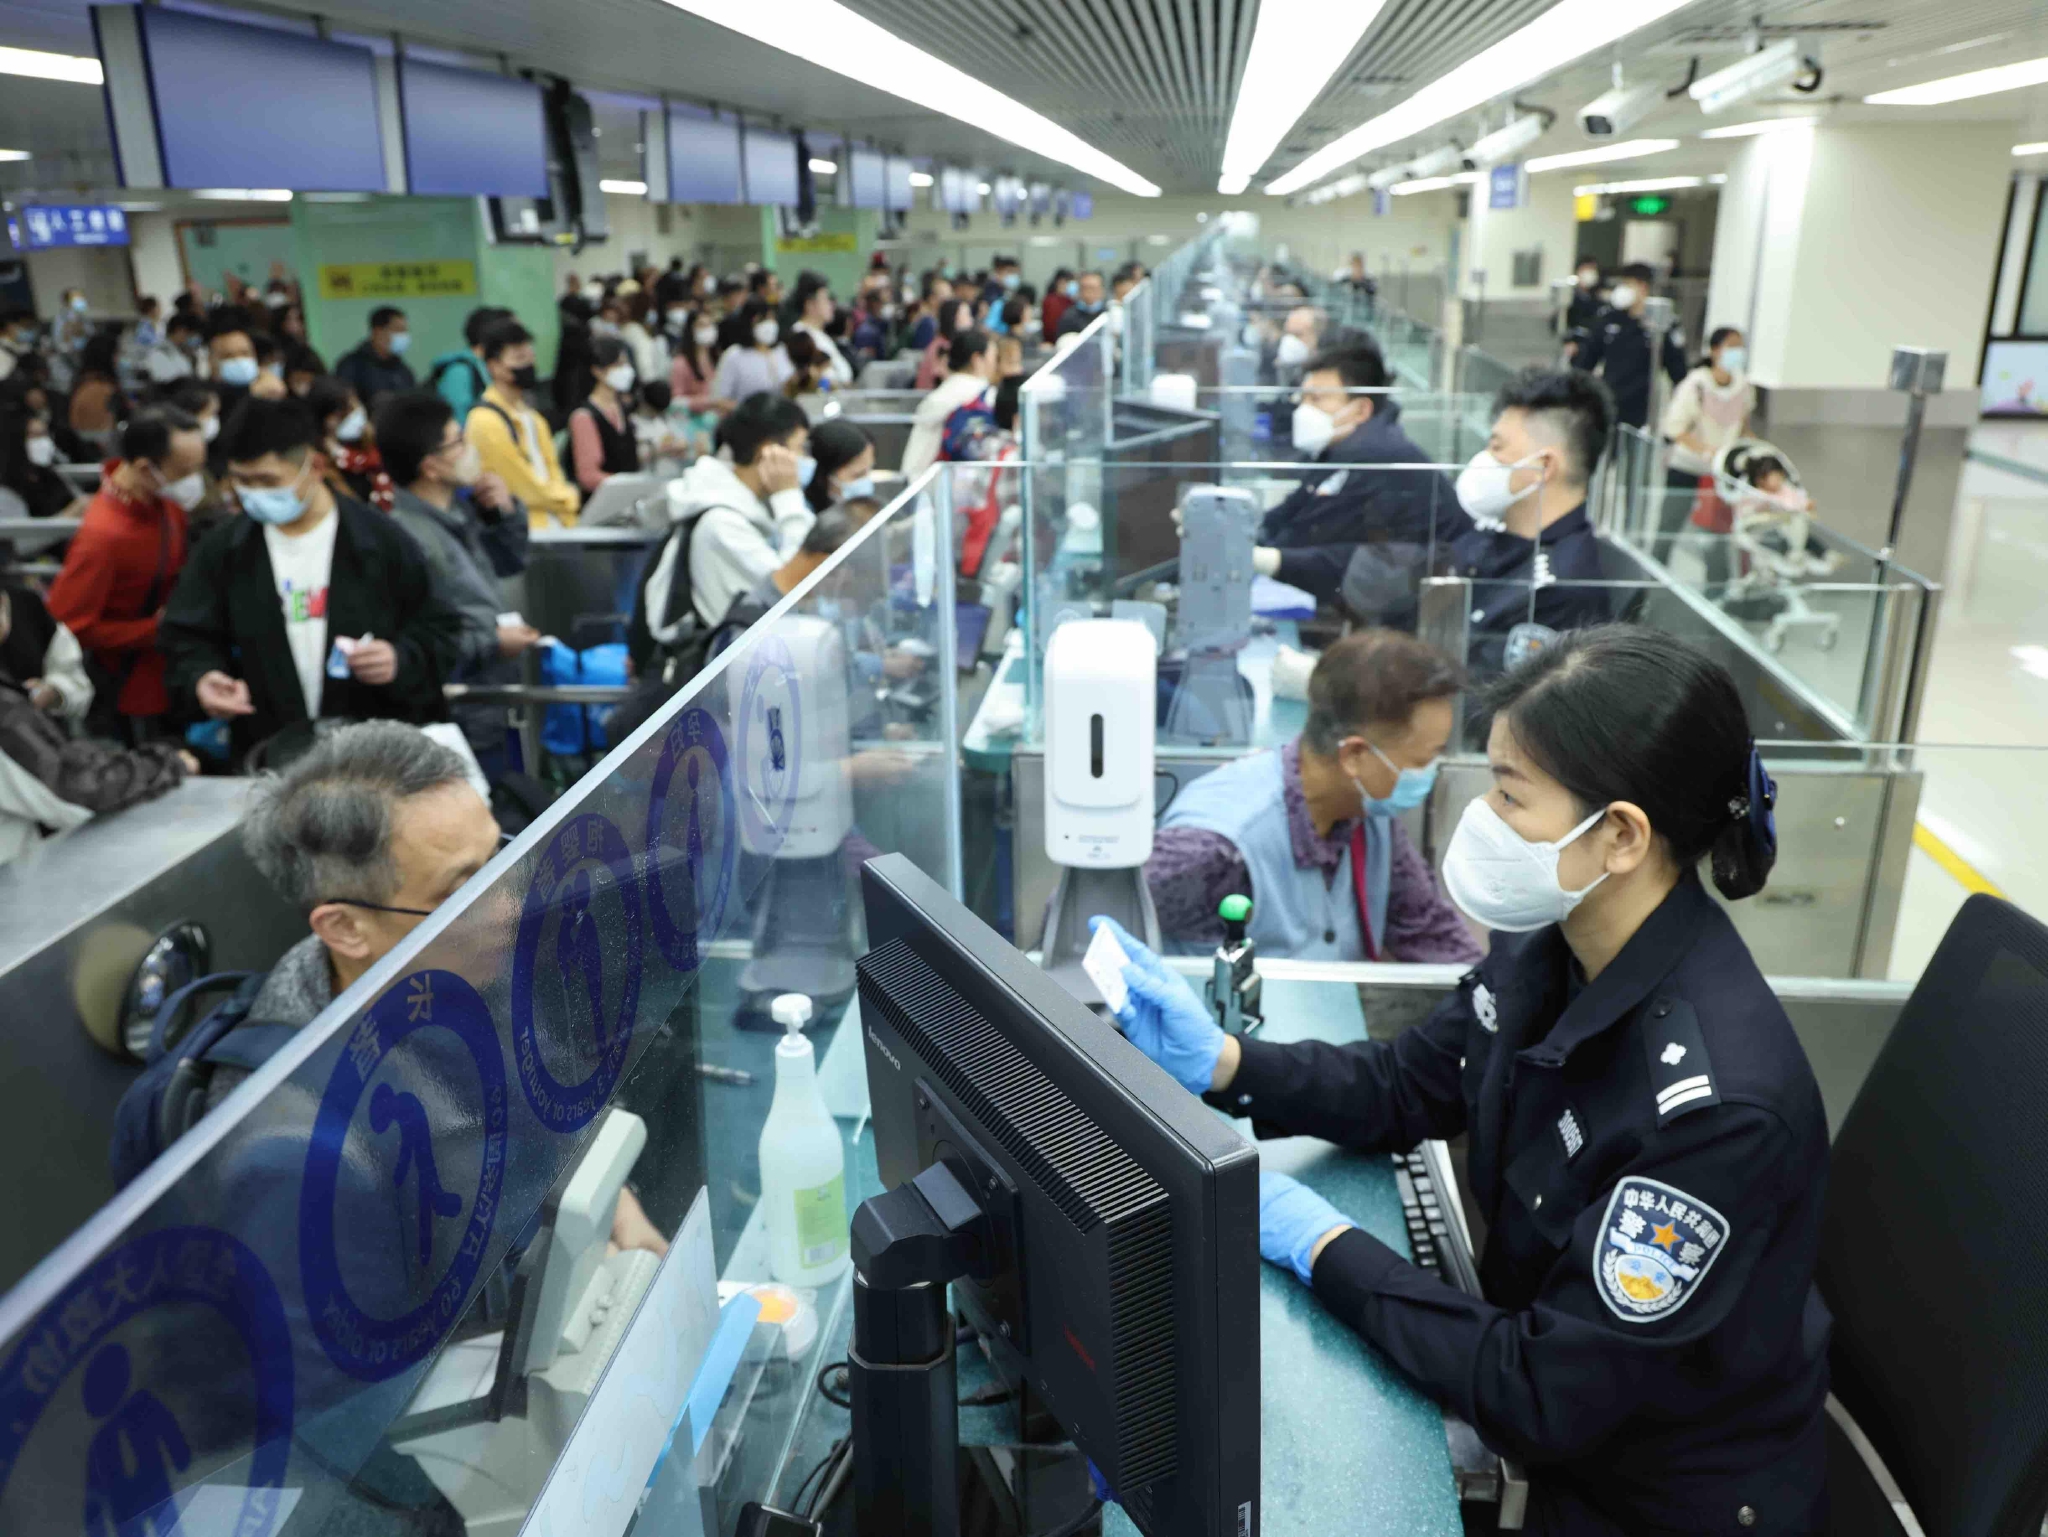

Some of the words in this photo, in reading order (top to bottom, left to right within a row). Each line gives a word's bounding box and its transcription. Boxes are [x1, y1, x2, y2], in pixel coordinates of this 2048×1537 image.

[51, 208, 125, 233] 人工
[1623, 1187, 1721, 1249] 中华人民共和国
